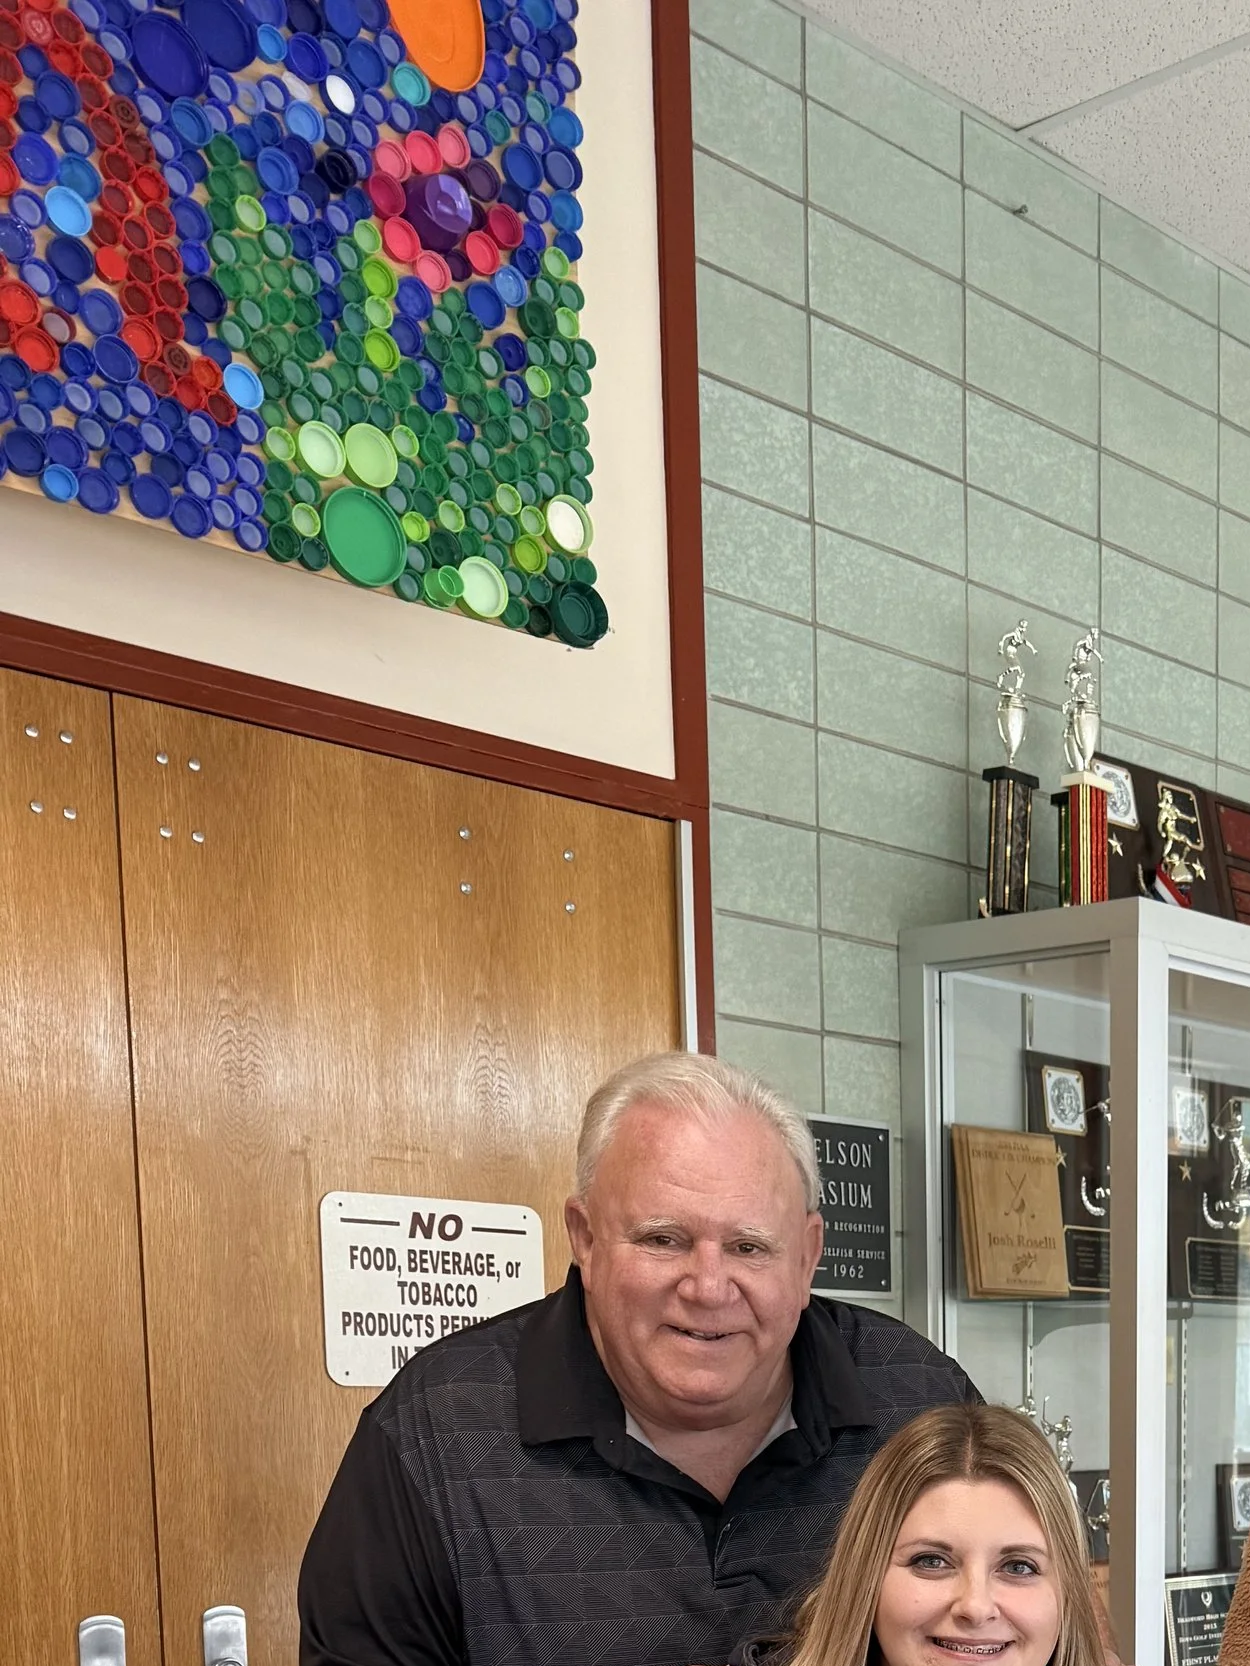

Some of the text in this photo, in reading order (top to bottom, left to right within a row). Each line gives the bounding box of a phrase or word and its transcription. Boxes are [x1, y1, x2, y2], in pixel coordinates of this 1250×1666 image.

[408, 1212, 463, 1241] NO
[834, 1221, 885, 1234] RECOGNITION
[988, 1232, 1014, 1247] Josh
[349, 1245, 521, 1282] FOOD, BEVERAGE, or
[857, 1250, 885, 1260] SERVICE
[834, 1264, 864, 1278] 1962
[397, 1280, 478, 1308] TOBACCO
[342, 1311, 434, 1338] PRODUCTS
[391, 1345, 409, 1370] IN
